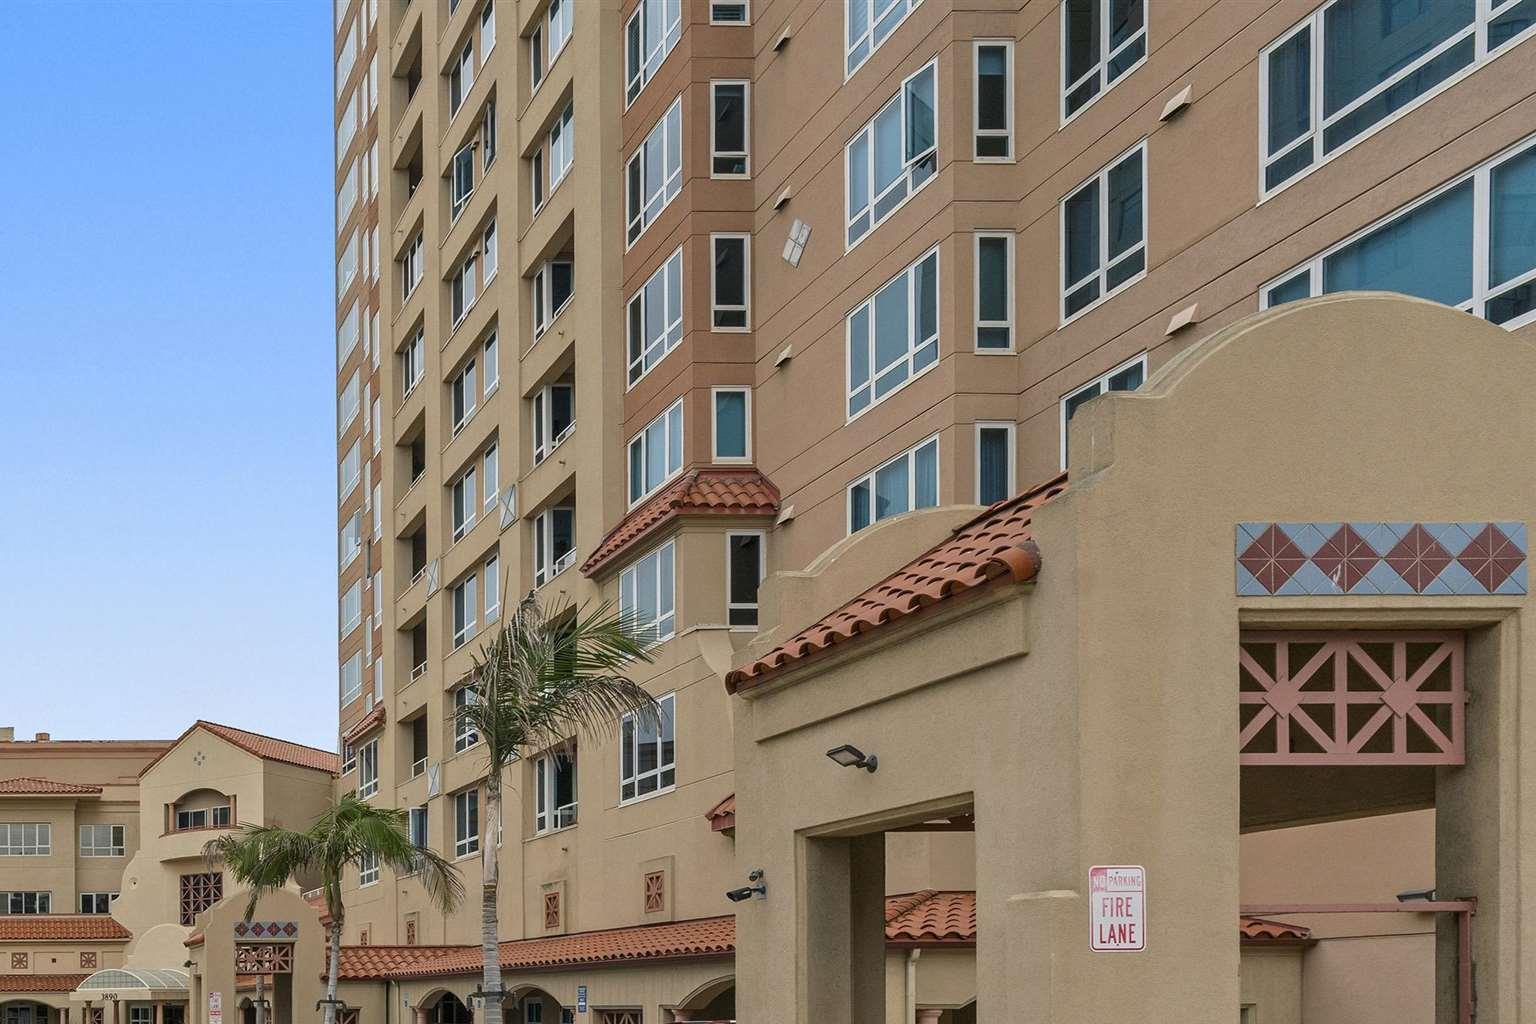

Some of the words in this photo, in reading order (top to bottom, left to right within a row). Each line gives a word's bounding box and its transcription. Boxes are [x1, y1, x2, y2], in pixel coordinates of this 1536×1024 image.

[1109, 876, 1142, 888] PARKING
[1102, 897, 1133, 918] FIRE
[1099, 923, 1136, 944] LANE
[101, 992, 118, 1001] 3890
